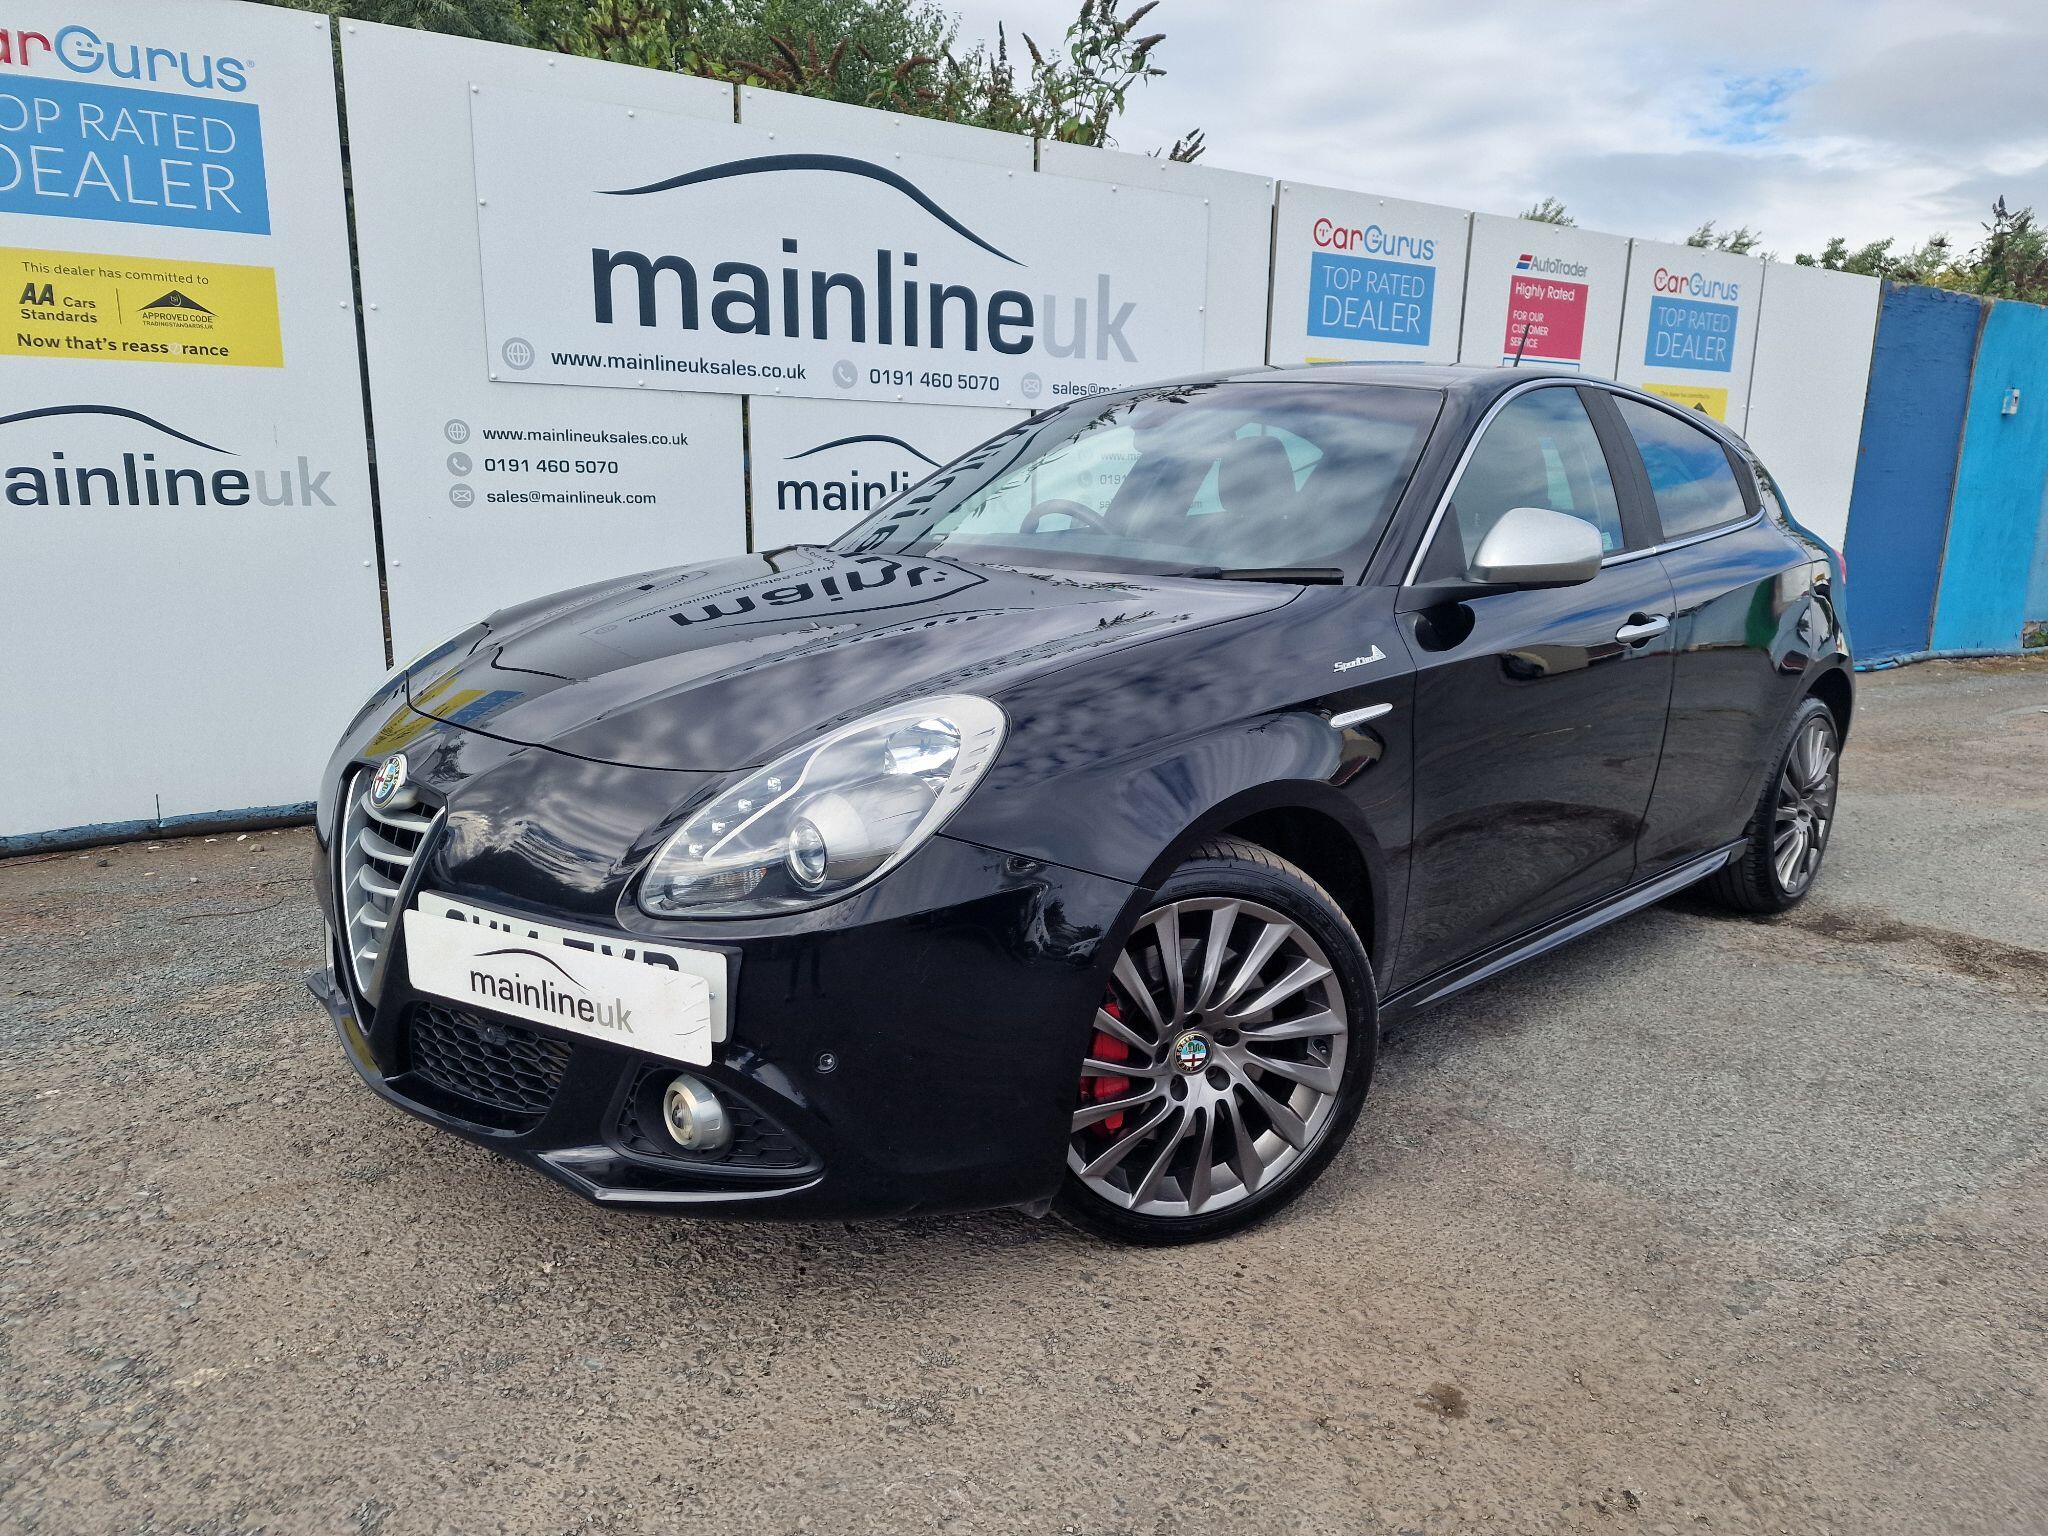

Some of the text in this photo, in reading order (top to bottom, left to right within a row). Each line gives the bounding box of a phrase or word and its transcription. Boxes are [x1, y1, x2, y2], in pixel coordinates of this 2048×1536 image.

[78, 103, 236, 154] RATED
[1313, 217, 1434, 261] CarGurus
[22, 261, 209, 286] This dealer has committed to
[1531, 255, 1588, 278] AutoTrader
[19, 282, 55, 306] AA
[1323, 265, 1425, 299] TOP RATED
[1515, 282, 1575, 302] Highly Rated
[1653, 267, 1738, 301] CarGurus
[63, 296, 96, 309] Cars
[592, 237, 1139, 363] mainlineuk
[20, 308, 98, 324] Standards
[142, 311, 214, 324] APPROVED CODE
[1322, 294, 1421, 334] DEALER
[1513, 310, 1545, 323] FOR OUR
[1658, 306, 1731, 333] TOP RATED
[17, 333, 60, 348] Now
[1511, 323, 1549, 336] CUSOMER
[1655, 331, 1727, 362] DEALER
[551, 351, 806, 380] www.mainlineuksales.co.uk
[869, 367, 999, 392] 0191 460 5070
[482, 428, 688, 446] www.mainlineuksales.co.uk
[484, 457, 619, 475] 0191 460 5070
[487, 489, 656, 505] sales@mainlineuk.com
[469, 969, 634, 1034] mainlineuk
